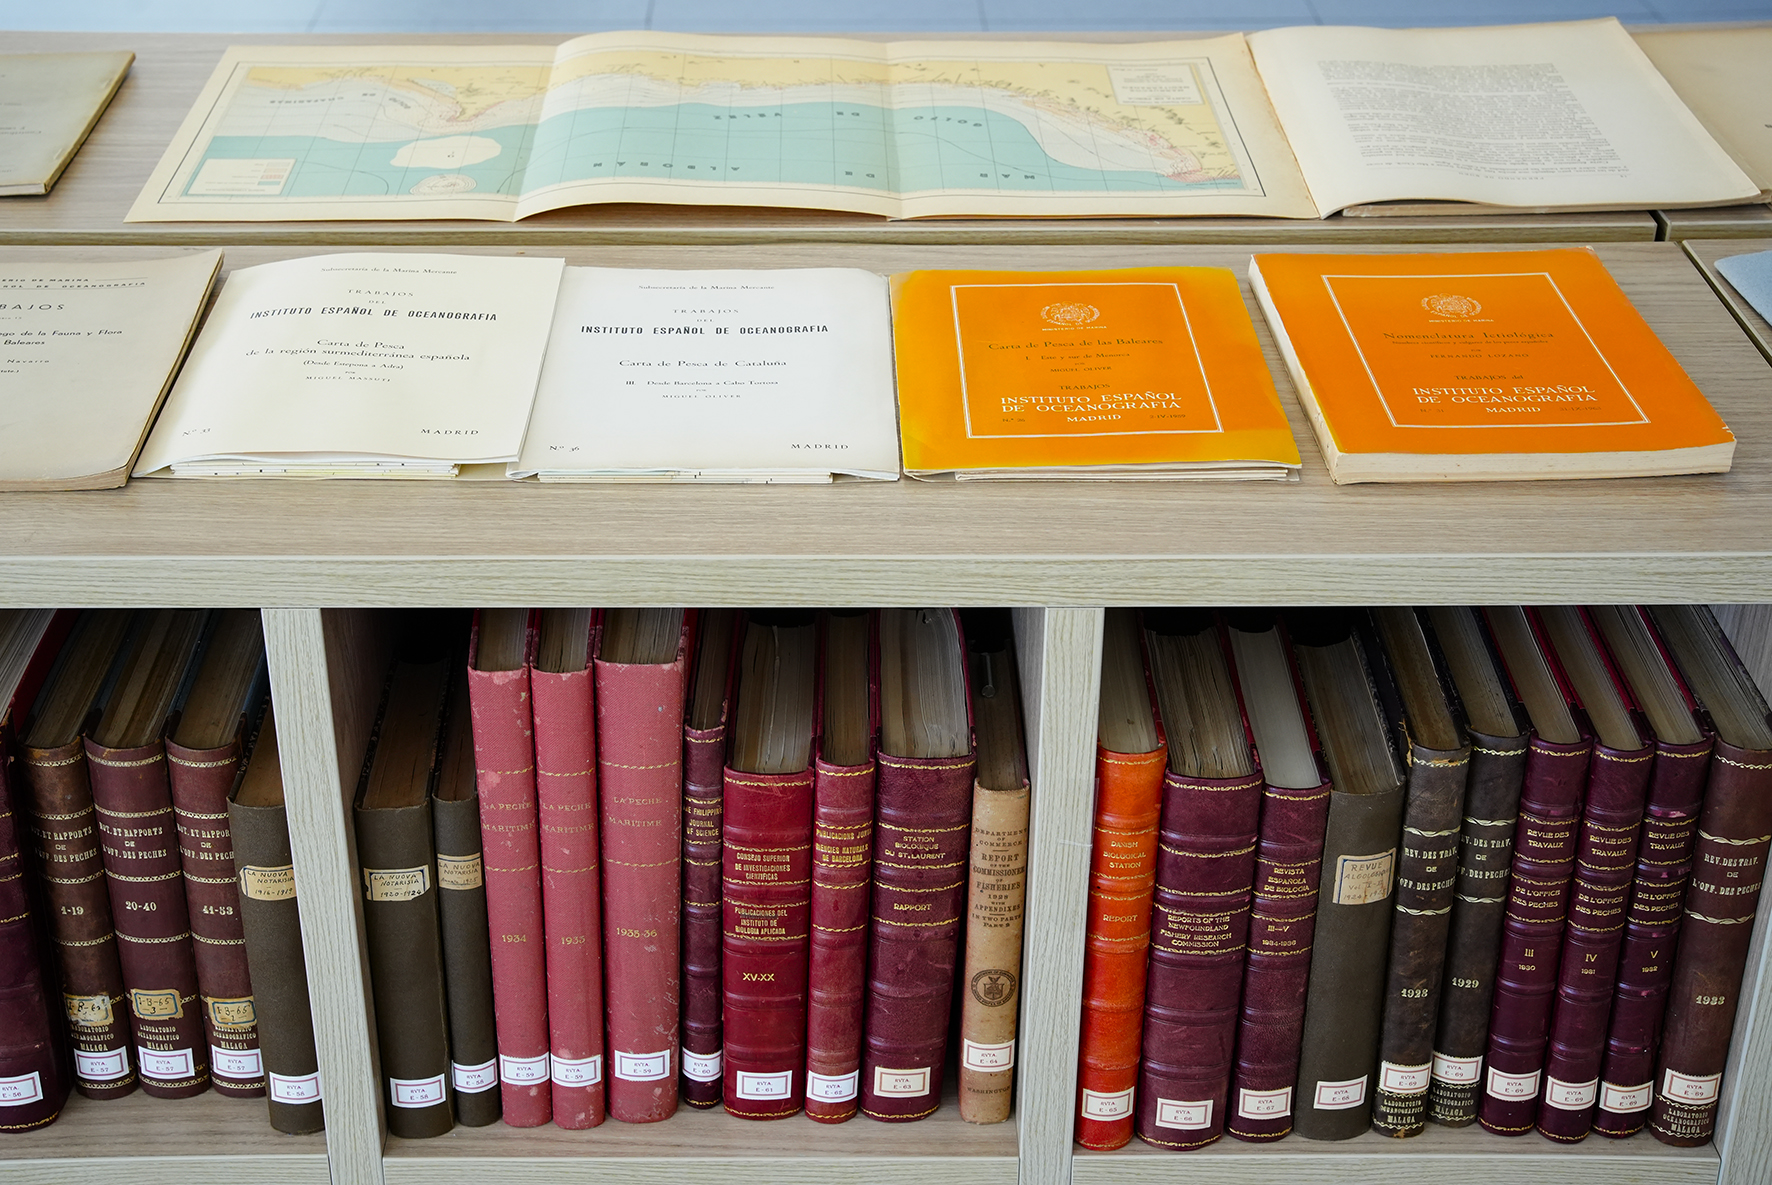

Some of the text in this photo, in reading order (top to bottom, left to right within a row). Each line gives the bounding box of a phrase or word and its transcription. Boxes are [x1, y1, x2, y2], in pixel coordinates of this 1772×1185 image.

[347, 288, 415, 297] TRABAJOS
[249, 305, 499, 322] INSTITUTO ESPAÑOL DE OCEANOGRAFIA
[581, 324, 829, 335] INSTITUTO ESPAÑOL DE OCEANOGRAFIA
[1383, 331, 1555, 340] Nomenclatura Ictiológica
[316, 338, 405, 350] Carta de Pesca
[988, 342, 1021, 350] Carta
[1044, 341, 1075, 349] Pesca
[1116, 338, 1164, 346] Baleares
[245, 347, 471, 362] de la región surmediterránea española
[619, 359, 652, 367] Carta
[735, 359, 788, 367] Cataluña
[1058, 383, 1111, 391] TRABAJOS
[1412, 385, 1596, 396] INSTITUTO ESPAÑOL
[1000, 390, 1182, 405] INSTITUTO ESPAÑOL
[1417, 393, 1598, 404] DE OCEANOGRAFIA
[1001, 400, 1182, 413] DE OCEANOGRAFIA
[1066, 413, 1122, 423] MADRID
[420, 428, 479, 436] MADRID
[498, 802, 532, 811] PECHE
[558, 802, 592, 812] PECHE
[608, 816, 663, 828] MARITIME
[689, 819, 715, 828] JOURNAL
[482, 822, 535, 833] MARITIME
[543, 822, 595, 834] MARITIME
[696, 827, 719, 837] SCIENCE
[54, 825, 93, 841] RAPPORTS
[1648, 830, 1690, 839] REVUE DES
[903, 835, 935, 843] STATION
[979, 839, 1023, 848] COMMERCE
[1473, 838, 1488, 848] DES
[1528, 839, 1563, 848] TRAVAUX
[1589, 835, 1616, 845] REVUE
[1111, 840, 1138, 848] DANISH
[1650, 842, 1685, 850] TRAVAUX
[69, 848, 98, 863] PECHES
[884, 849, 896, 857] DU
[1103, 851, 1147, 860] BIOLOGICAL
[1422, 849, 1437, 860] DES
[1591, 848, 1627, 857] TRAVAUX
[736, 852, 790, 863] CONSEJO SUPERIOR
[831, 854, 863, 863] BARCELONA
[981, 853, 1020, 862] REPORT
[452, 861, 480, 870] NUOVA
[743, 864, 791, 872] INVESTIGACIONES
[1109, 861, 1141, 869] STATION
[1350, 861, 1384, 872] REVUE
[972, 866, 1026, 877] COMMISSIONER
[1274, 867, 1305, 875] REVISTA
[388, 873, 417, 881] NUOVA
[745, 872, 779, 881] CIENTIFICAS
[1267, 876, 1307, 885] ESPAÑOLA
[380, 878, 419, 887] NOTARISIA
[976, 881, 1021, 891] FISHERIES
[1276, 885, 1310, 893] BIOLOGIA
[1719, 881, 1762, 896] DES PECHES
[1512, 895, 1527, 905] DES
[125, 900, 157, 912] 20-40
[893, 903, 932, 911] RAPPORT
[974, 904, 1021, 913] APPENDIXES
[1575, 904, 1591, 914] DES
[1633, 902, 1650, 912] DES
[734, 906, 788, 917] PUBLICACIONES DEL
[740, 918, 769, 927] INSTITUTO
[1103, 914, 1138, 923] REPORT
[1167, 914, 1230, 923] REPORTS THE
[761, 927, 786, 935] APLICADA
[1168, 922, 1229, 932] NEWFOUNDLAND
[501, 934, 527, 943] 1934
[1160, 929, 1232, 941] FISHERY RESEARCH
[1171, 939, 1219, 948] COMMISSION
[1524, 948, 1535, 958] III
[1651, 950, 1658, 959] V
[1585, 954, 1598, 962] IV
[1451, 977, 1479, 989] 1929
[1401, 988, 1428, 998] 1928
[220, 1040, 248, 1050] MALAGA
